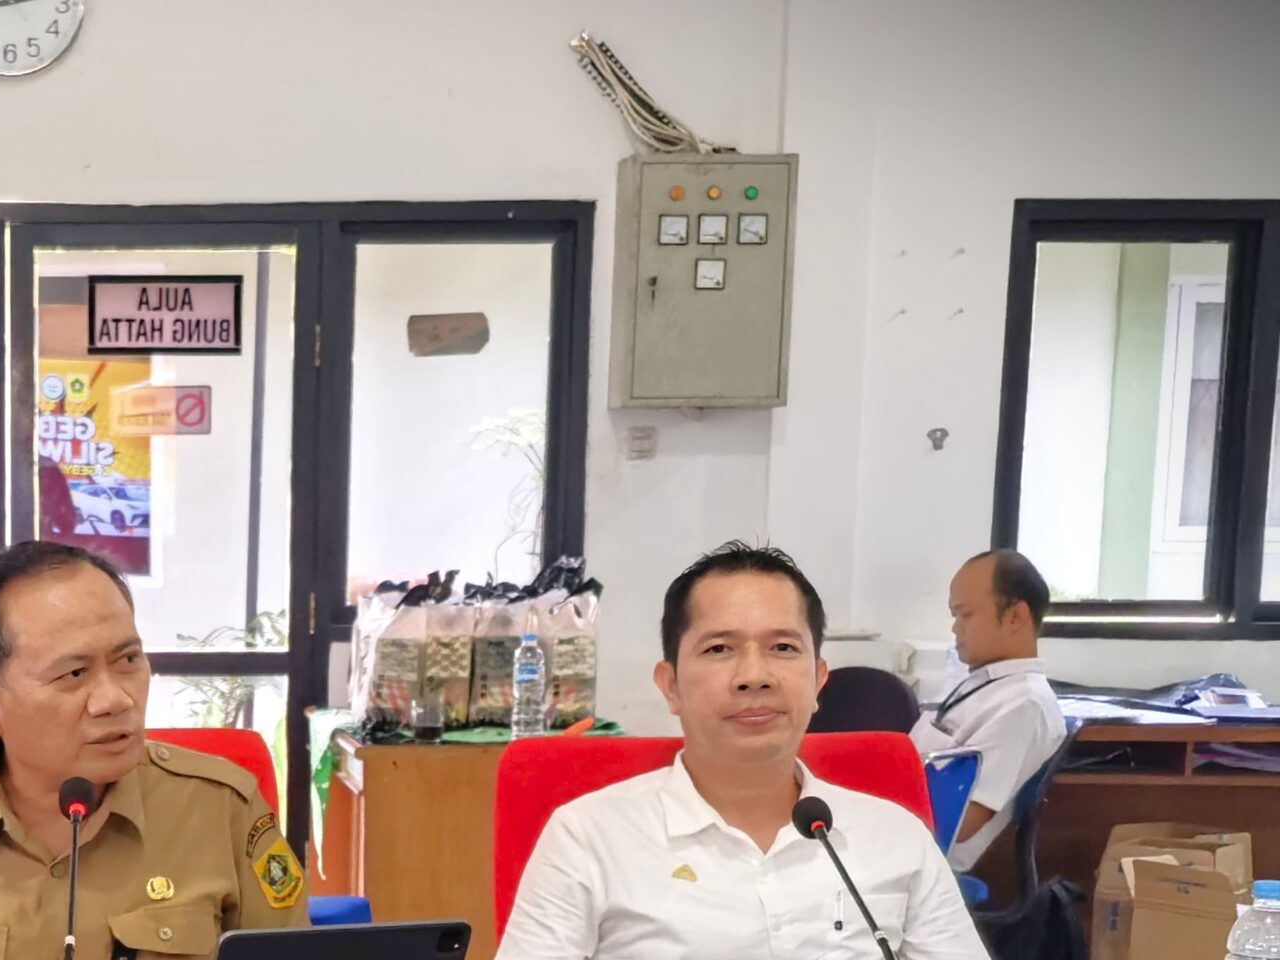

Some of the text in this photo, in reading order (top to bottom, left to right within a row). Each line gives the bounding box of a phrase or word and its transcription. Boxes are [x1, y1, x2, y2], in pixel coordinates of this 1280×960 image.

[55, 0, 70, 14] 3
[45, 19, 60, 38] 4
[3, 43, 18, 64] 6
[26, 37, 41, 58] 5
